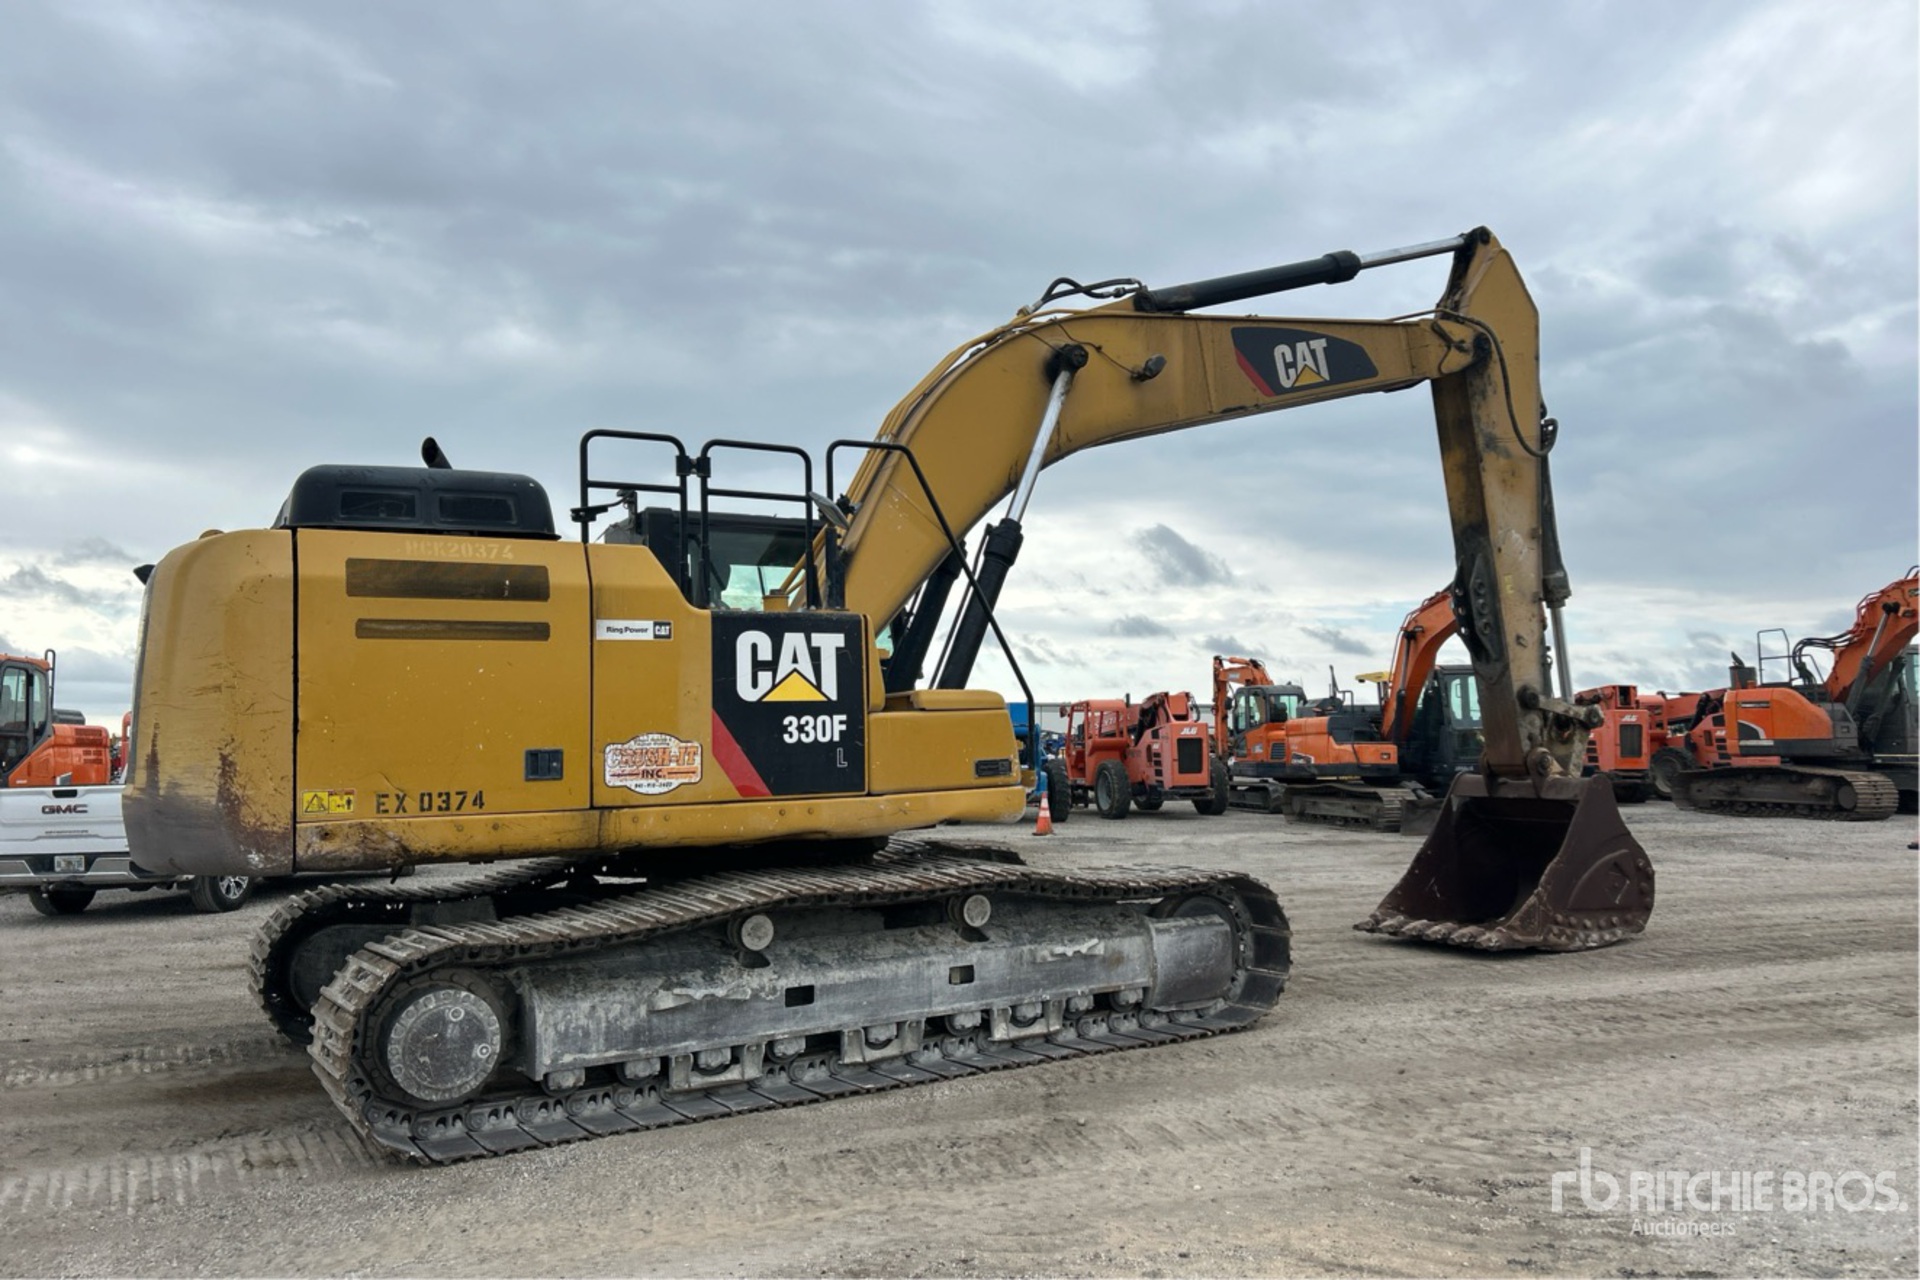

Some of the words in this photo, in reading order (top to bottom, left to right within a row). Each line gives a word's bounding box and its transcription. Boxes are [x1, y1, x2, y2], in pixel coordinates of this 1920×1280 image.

[1273, 338, 1330, 388] CAT
[606, 626, 623, 634] Ring
[655, 625, 670, 635] CAT
[736, 630, 845, 702] CAT
[783, 714, 847, 744] 330F
[836, 747, 848, 768] L
[641, 769, 666, 779] INC.
[41, 804, 88, 814] GMC
[375, 793, 407, 814] EX
[419, 790, 486, 812] 0374
